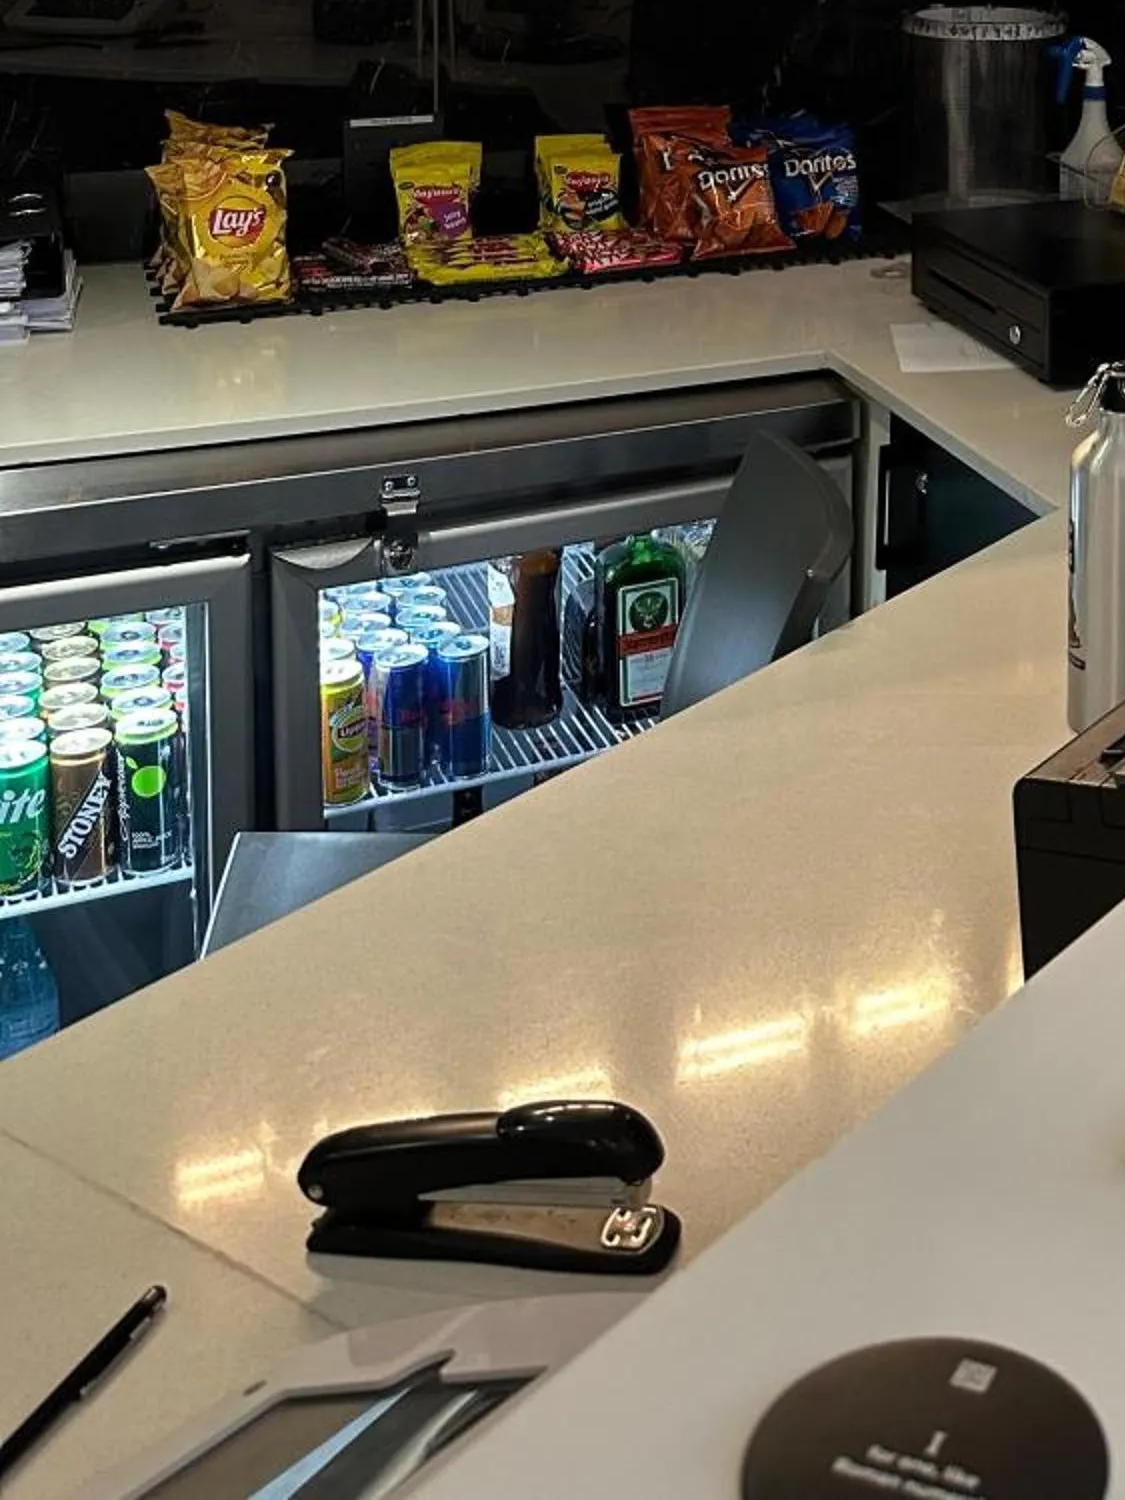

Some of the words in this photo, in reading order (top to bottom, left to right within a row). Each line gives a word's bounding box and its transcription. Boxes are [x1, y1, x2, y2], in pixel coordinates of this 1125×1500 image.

[784, 153, 858, 178] Doritos
[212, 207, 264, 237] Lay's
[0, 787, 47, 825] ite
[57, 772, 113, 860] STONEY
